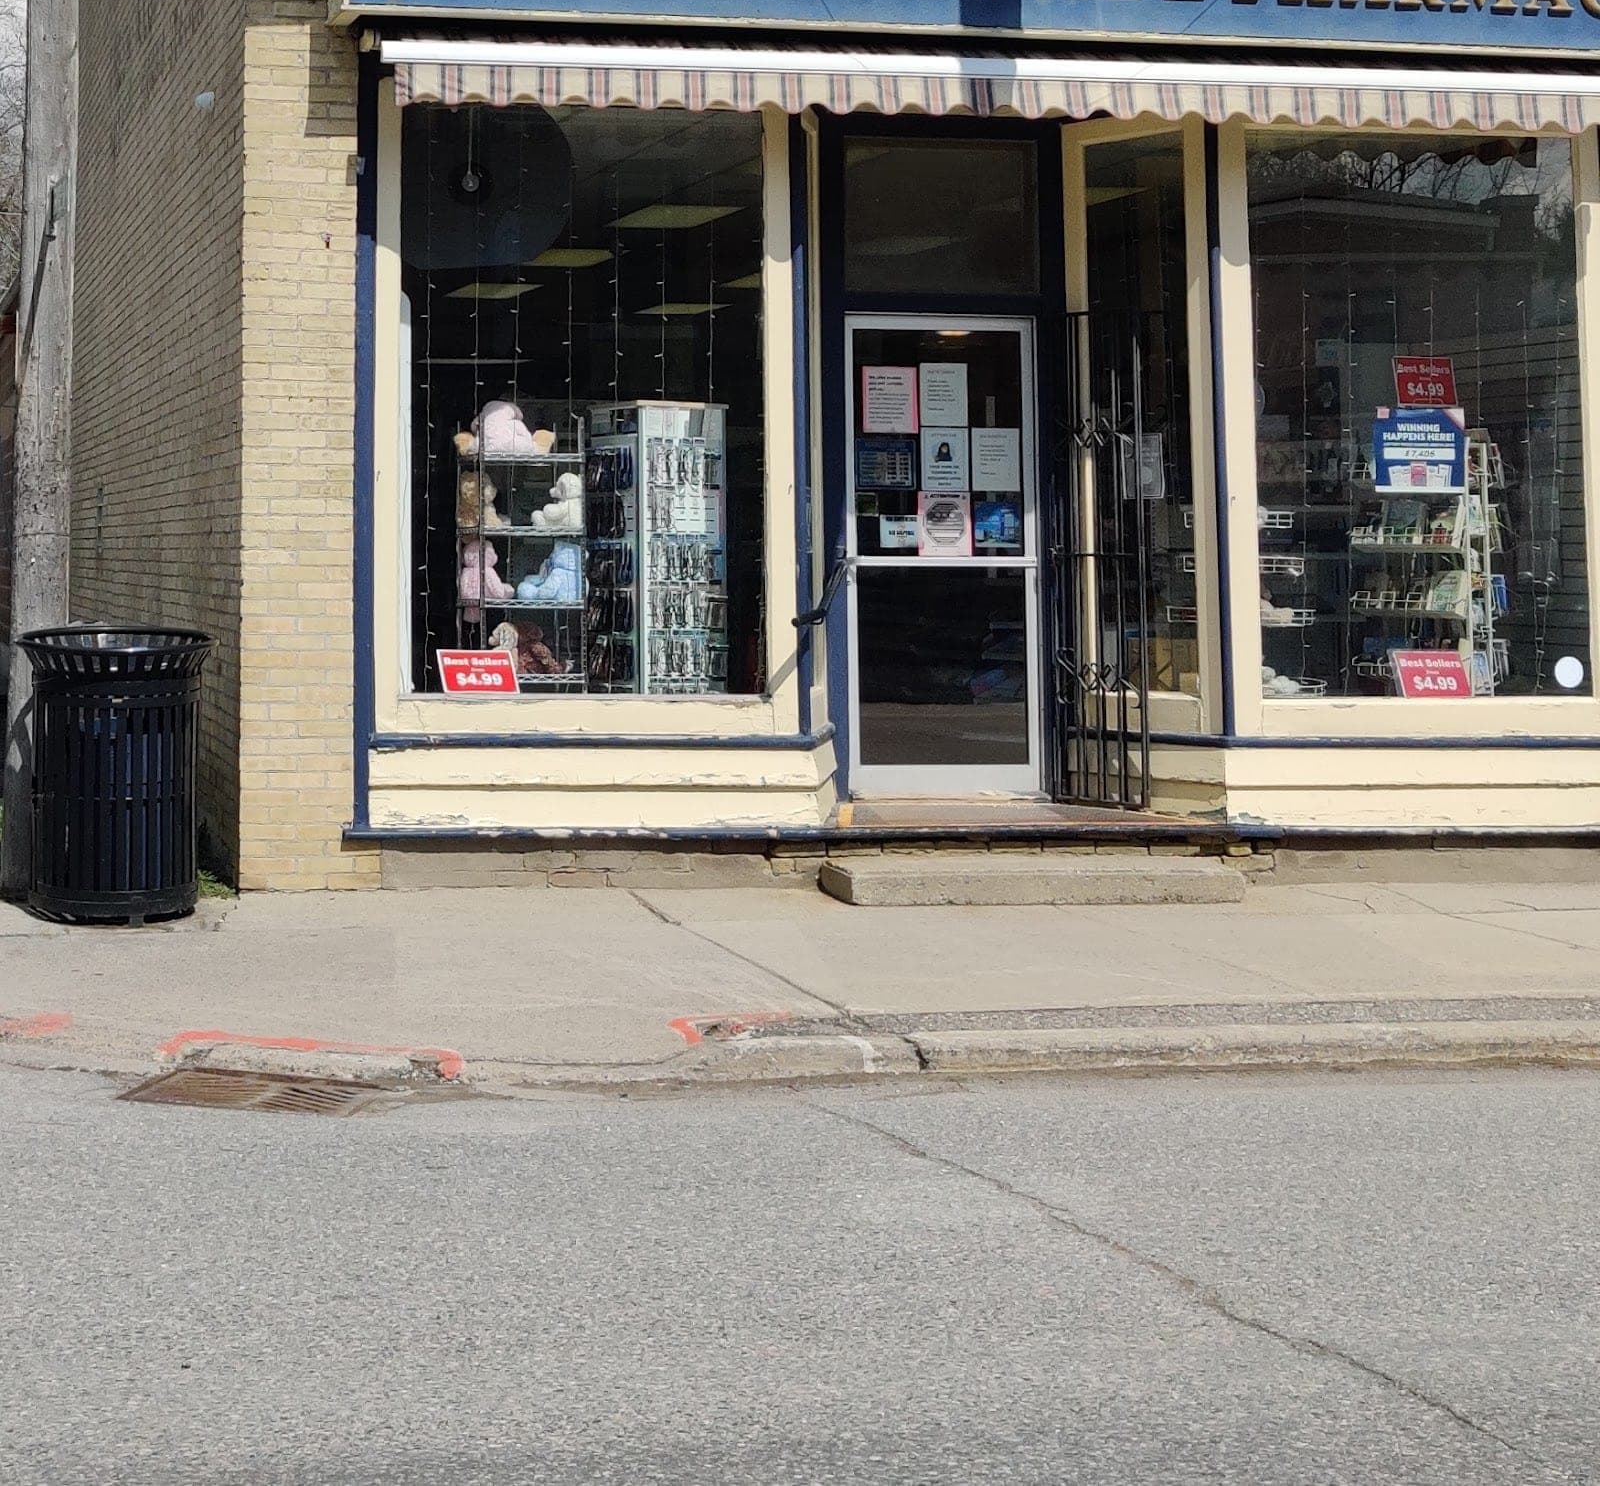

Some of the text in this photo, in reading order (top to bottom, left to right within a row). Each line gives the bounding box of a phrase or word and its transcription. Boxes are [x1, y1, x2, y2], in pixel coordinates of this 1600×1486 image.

[1396, 363, 1418, 374] Best
[1407, 382, 1445, 396] $4.99
[1397, 422, 1440, 432] WINNING
[1383, 432, 1455, 442] HAPPENS HERE!
[443, 656, 509, 667] Best Sellers
[1399, 658, 1462, 668] Best Sellers
[455, 672, 504, 687] $4.99
[1413, 675, 1458, 692] $4.99
